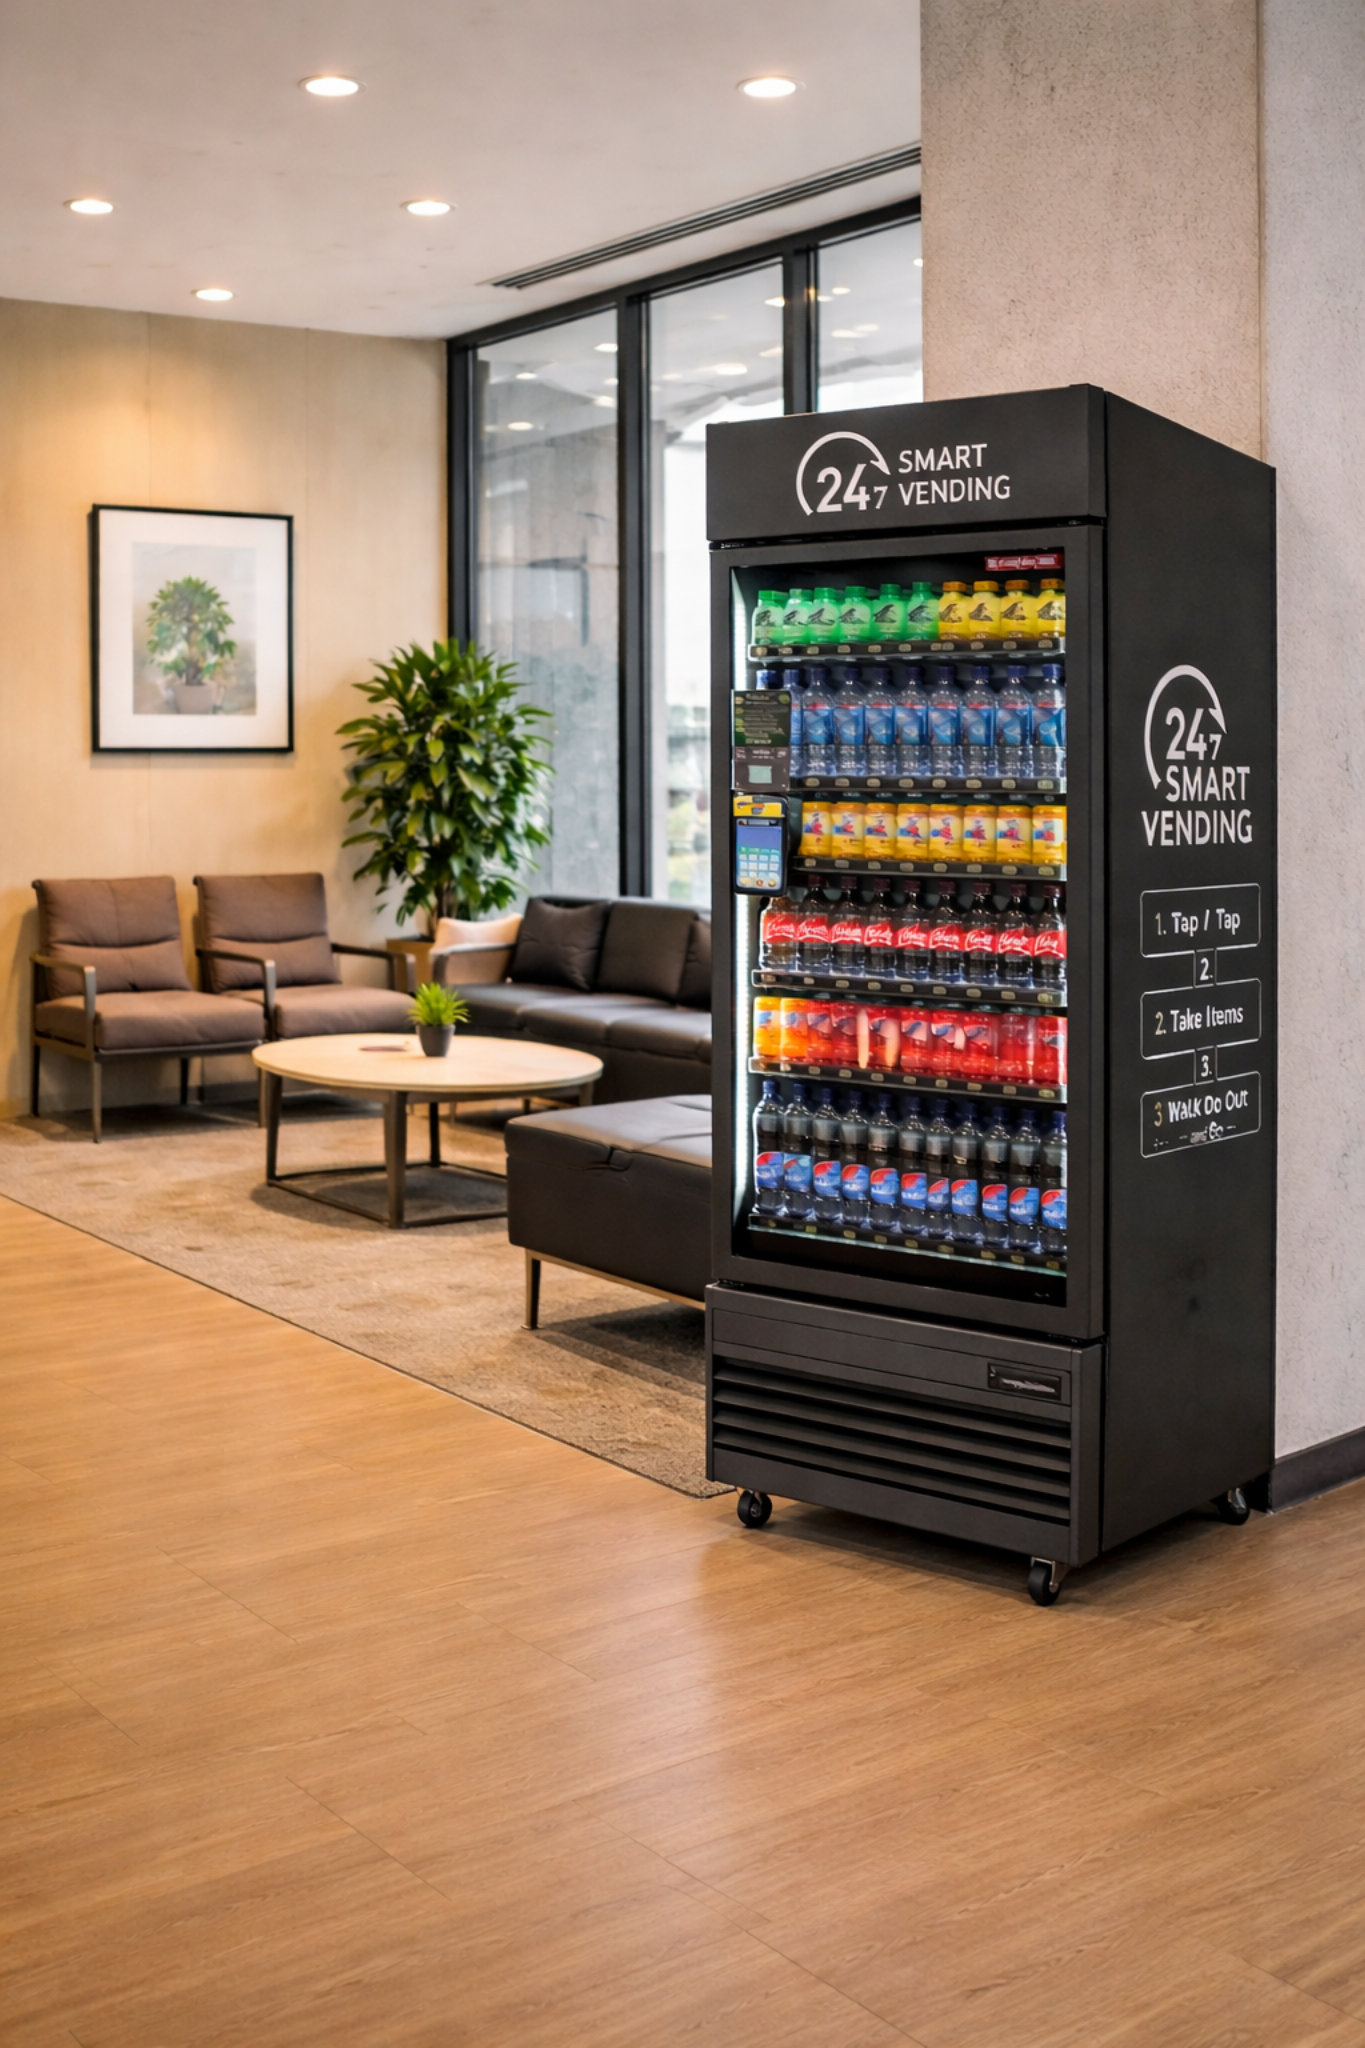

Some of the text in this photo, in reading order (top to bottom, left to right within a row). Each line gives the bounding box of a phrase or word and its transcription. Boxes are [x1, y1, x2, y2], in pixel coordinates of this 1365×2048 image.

[898, 443, 988, 474] SMART
[898, 475, 1011, 506] VENDING
[1165, 765, 1250, 802] SMART
[1141, 808, 1253, 847] VENDING
[1171, 911, 1199, 937] Tap
[1203, 908, 1210, 931] /
[1216, 908, 1241, 935] Tap
[1199, 957, 1213, 981] 2.
[1155, 1004, 1244, 1036] 2. Take Items
[1200, 1054, 1213, 1078] 3.
[1225, 1090, 1249, 1112] Out
